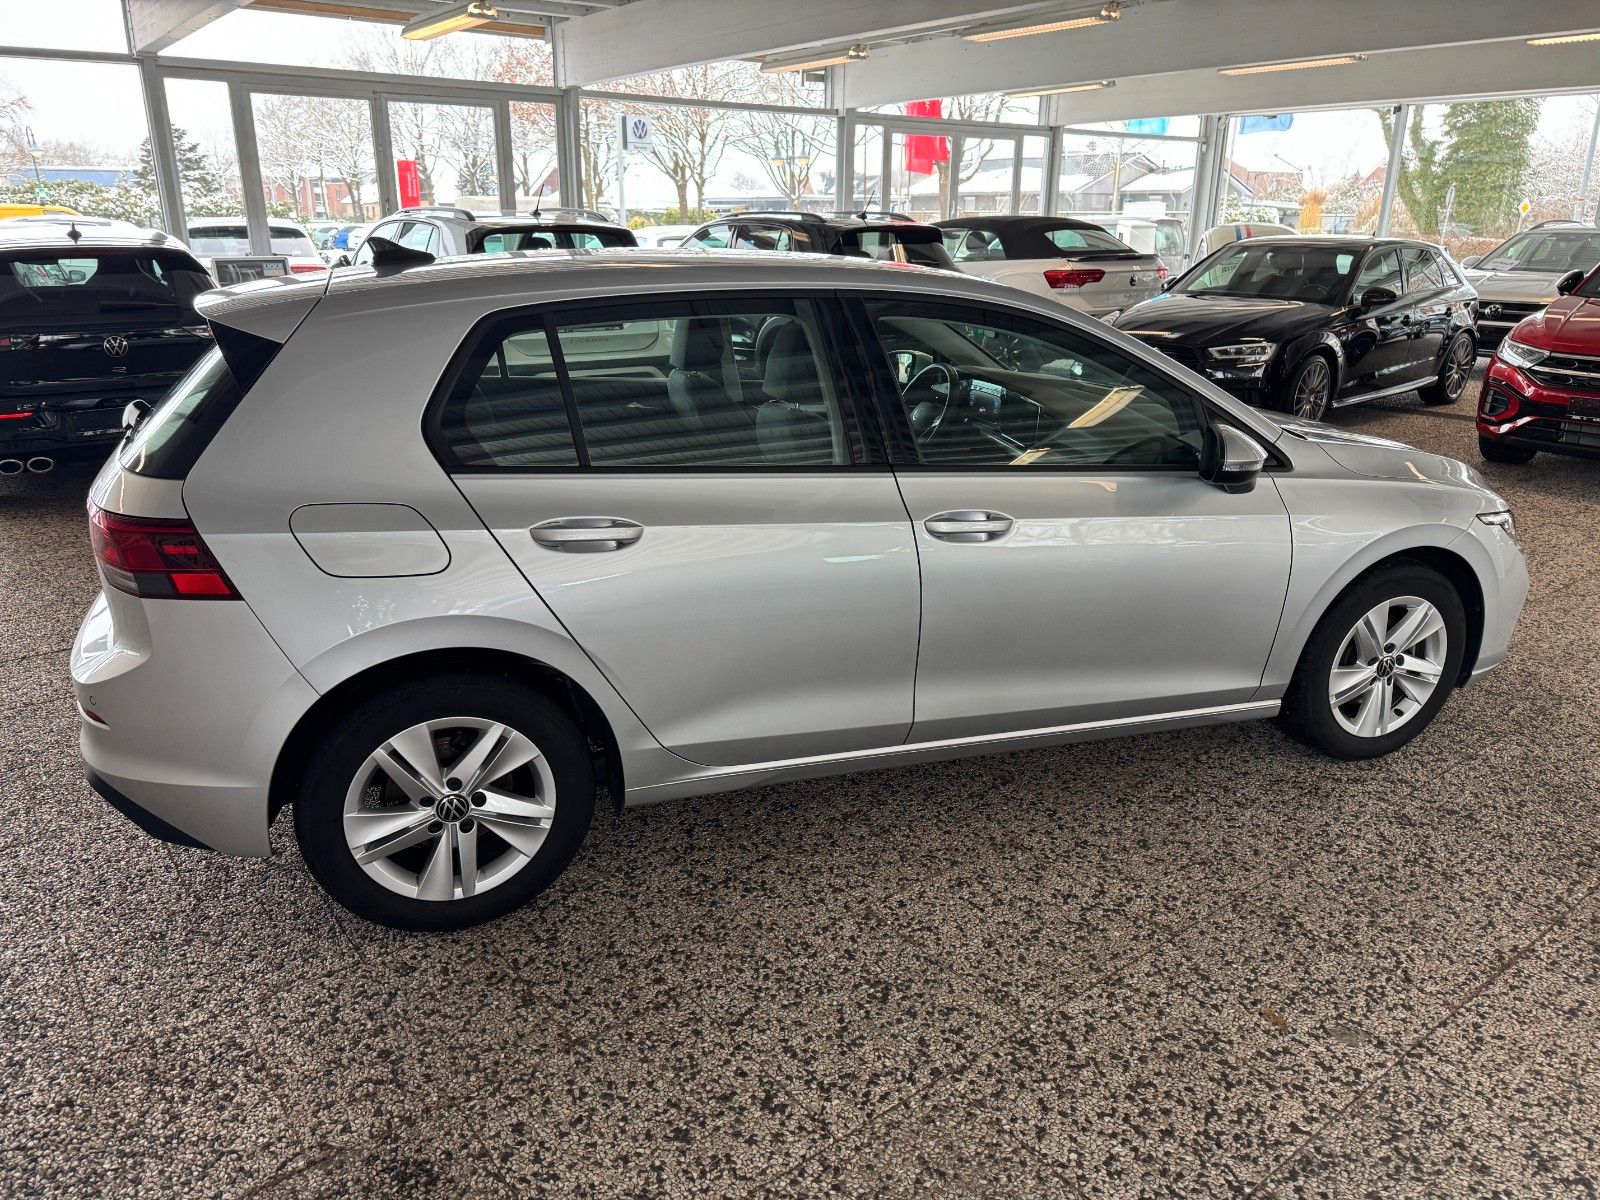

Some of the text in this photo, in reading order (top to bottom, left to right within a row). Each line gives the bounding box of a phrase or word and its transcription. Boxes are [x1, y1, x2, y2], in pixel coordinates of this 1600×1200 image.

[632, 119, 648, 139] VW
[103, 335, 128, 357] VW
[438, 795, 468, 821] VW
